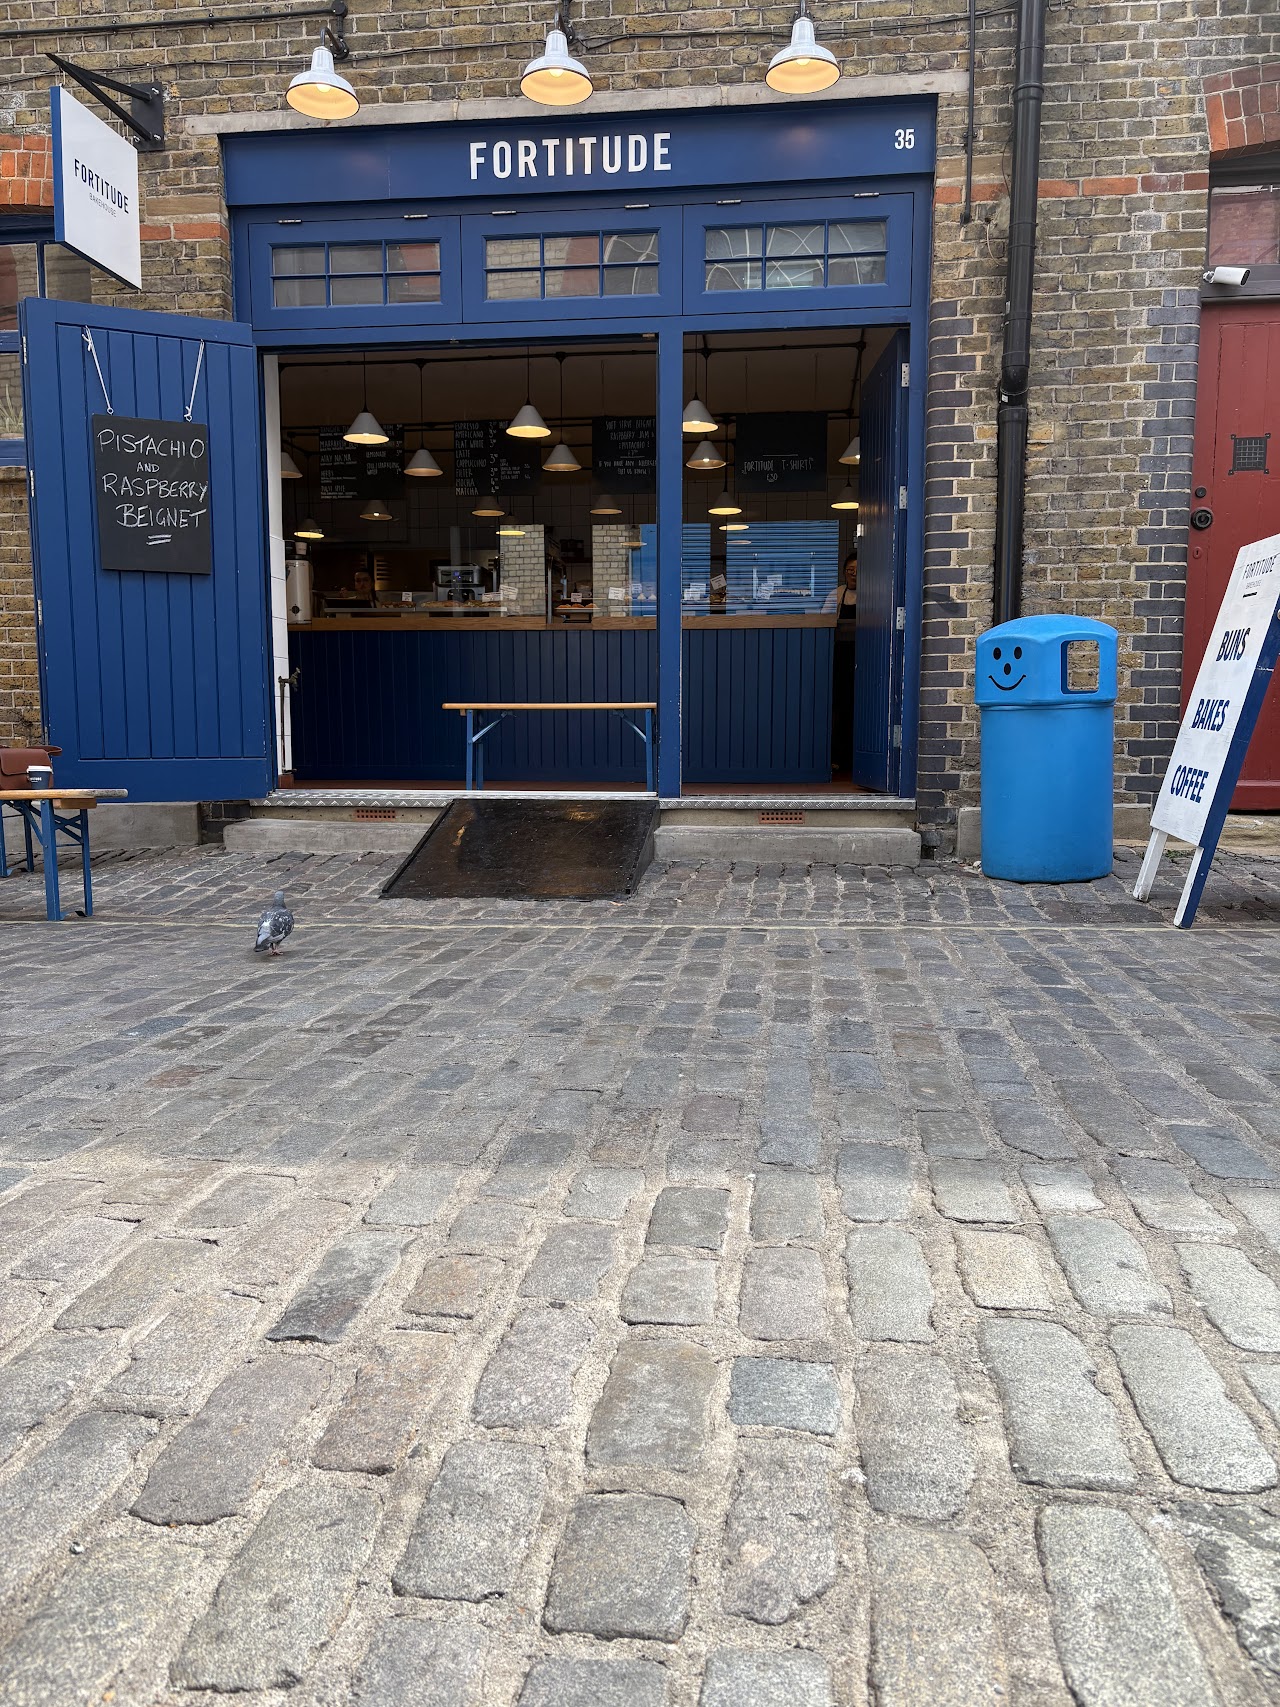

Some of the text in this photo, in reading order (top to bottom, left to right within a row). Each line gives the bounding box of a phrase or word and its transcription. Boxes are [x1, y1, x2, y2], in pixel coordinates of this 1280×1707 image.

[894, 128, 915, 150] 35
[470, 132, 671, 180] FORTITUDE
[74, 158, 130, 215] FORTITUDE
[89, 193, 117, 218] BAKEHOUSE
[455, 422, 479, 430] ESPRESSO
[455, 430, 484, 439] AMERICANO
[97, 429, 205, 458] PISTACHIO
[455, 440, 467, 449] FLAT
[469, 440, 484, 448] WHITE
[455, 450, 470, 459] LATTE
[136, 462, 160, 473] AND
[456, 459, 487, 468] CAPPUCCINO
[456, 469, 473, 478] FILTER
[744, 460, 774, 472] FORTITUDE
[101, 472, 208, 503] RASPBERRY
[456, 478, 475, 487] MOCHA
[456, 487, 479, 496] MATCHA
[115, 504, 207, 528] BEIGNET
[1242, 555, 1277, 580] FORTITUDE
[1216, 628, 1251, 662] BUNS
[1191, 698, 1230, 733] BAKES
[1170, 764, 1209, 804] COFFEE
